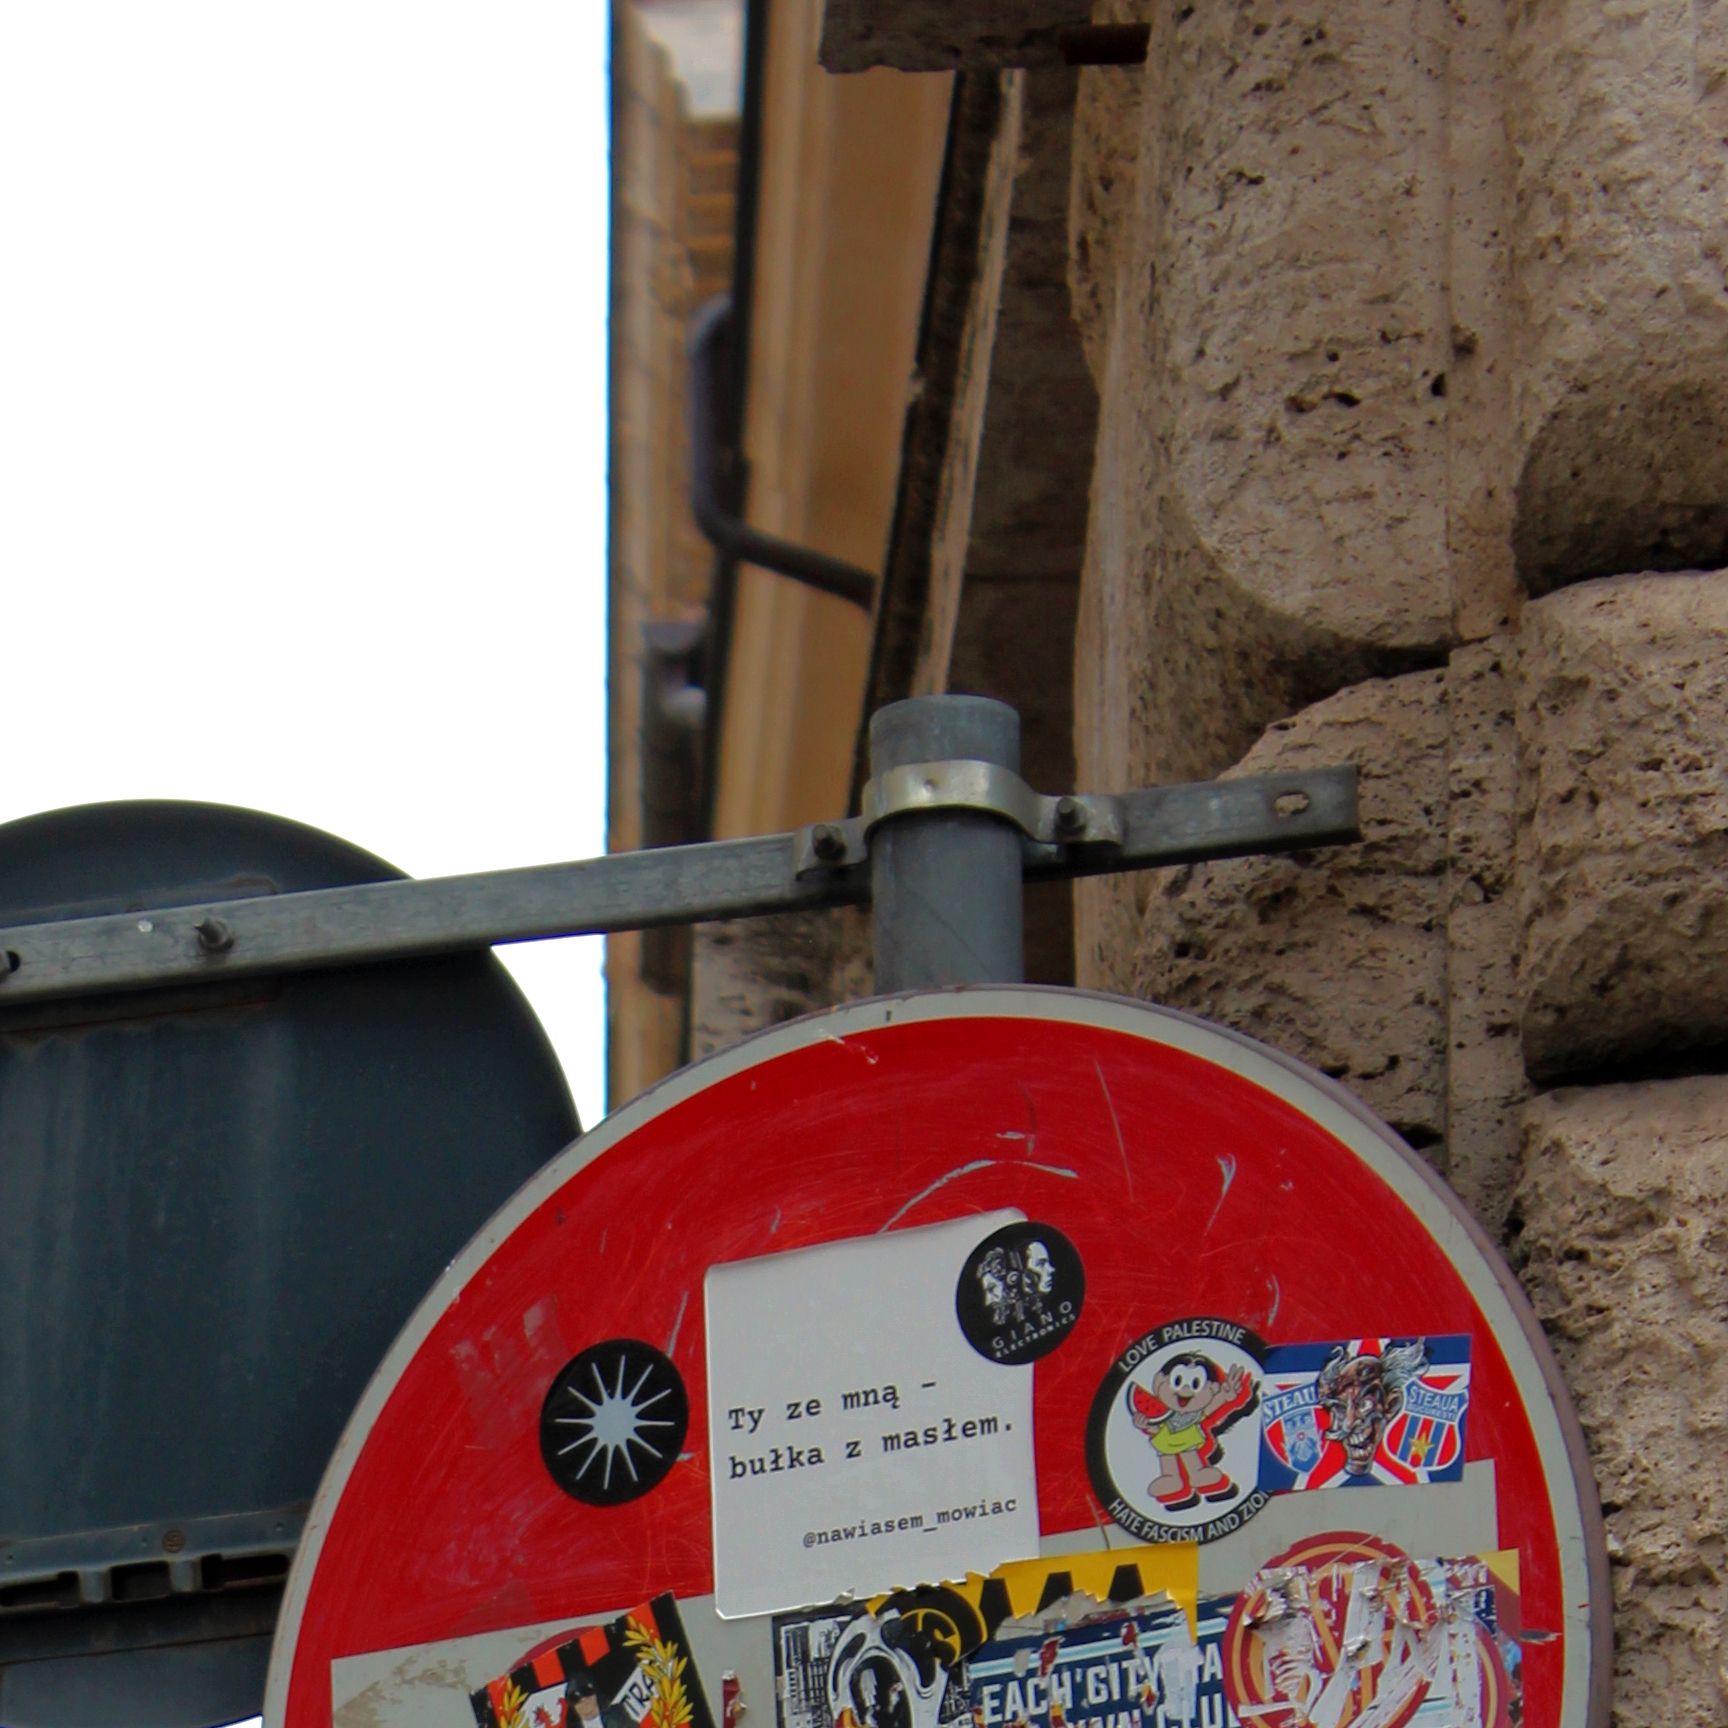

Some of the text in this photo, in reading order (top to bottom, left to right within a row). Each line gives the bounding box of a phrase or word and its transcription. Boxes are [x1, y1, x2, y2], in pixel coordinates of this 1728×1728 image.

[992, 1301, 1073, 1350] GIANO
[1119, 1320, 1246, 1373] LOVE PALESTINE
[728, 1407, 765, 1433] Ty
[787, 1398, 822, 1421] ze
[842, 1382, 900, 1410] mną
[1410, 1385, 1459, 1413] STEAUA
[729, 1415, 1013, 1479] bułka z masłem.
[802, 1497, 1017, 1548] @nawiasem_mowiac
[1108, 1500, 1139, 1534] HATE
[1141, 1522, 1204, 1544] FASCISM
[1207, 1514, 1240, 1542] AND
